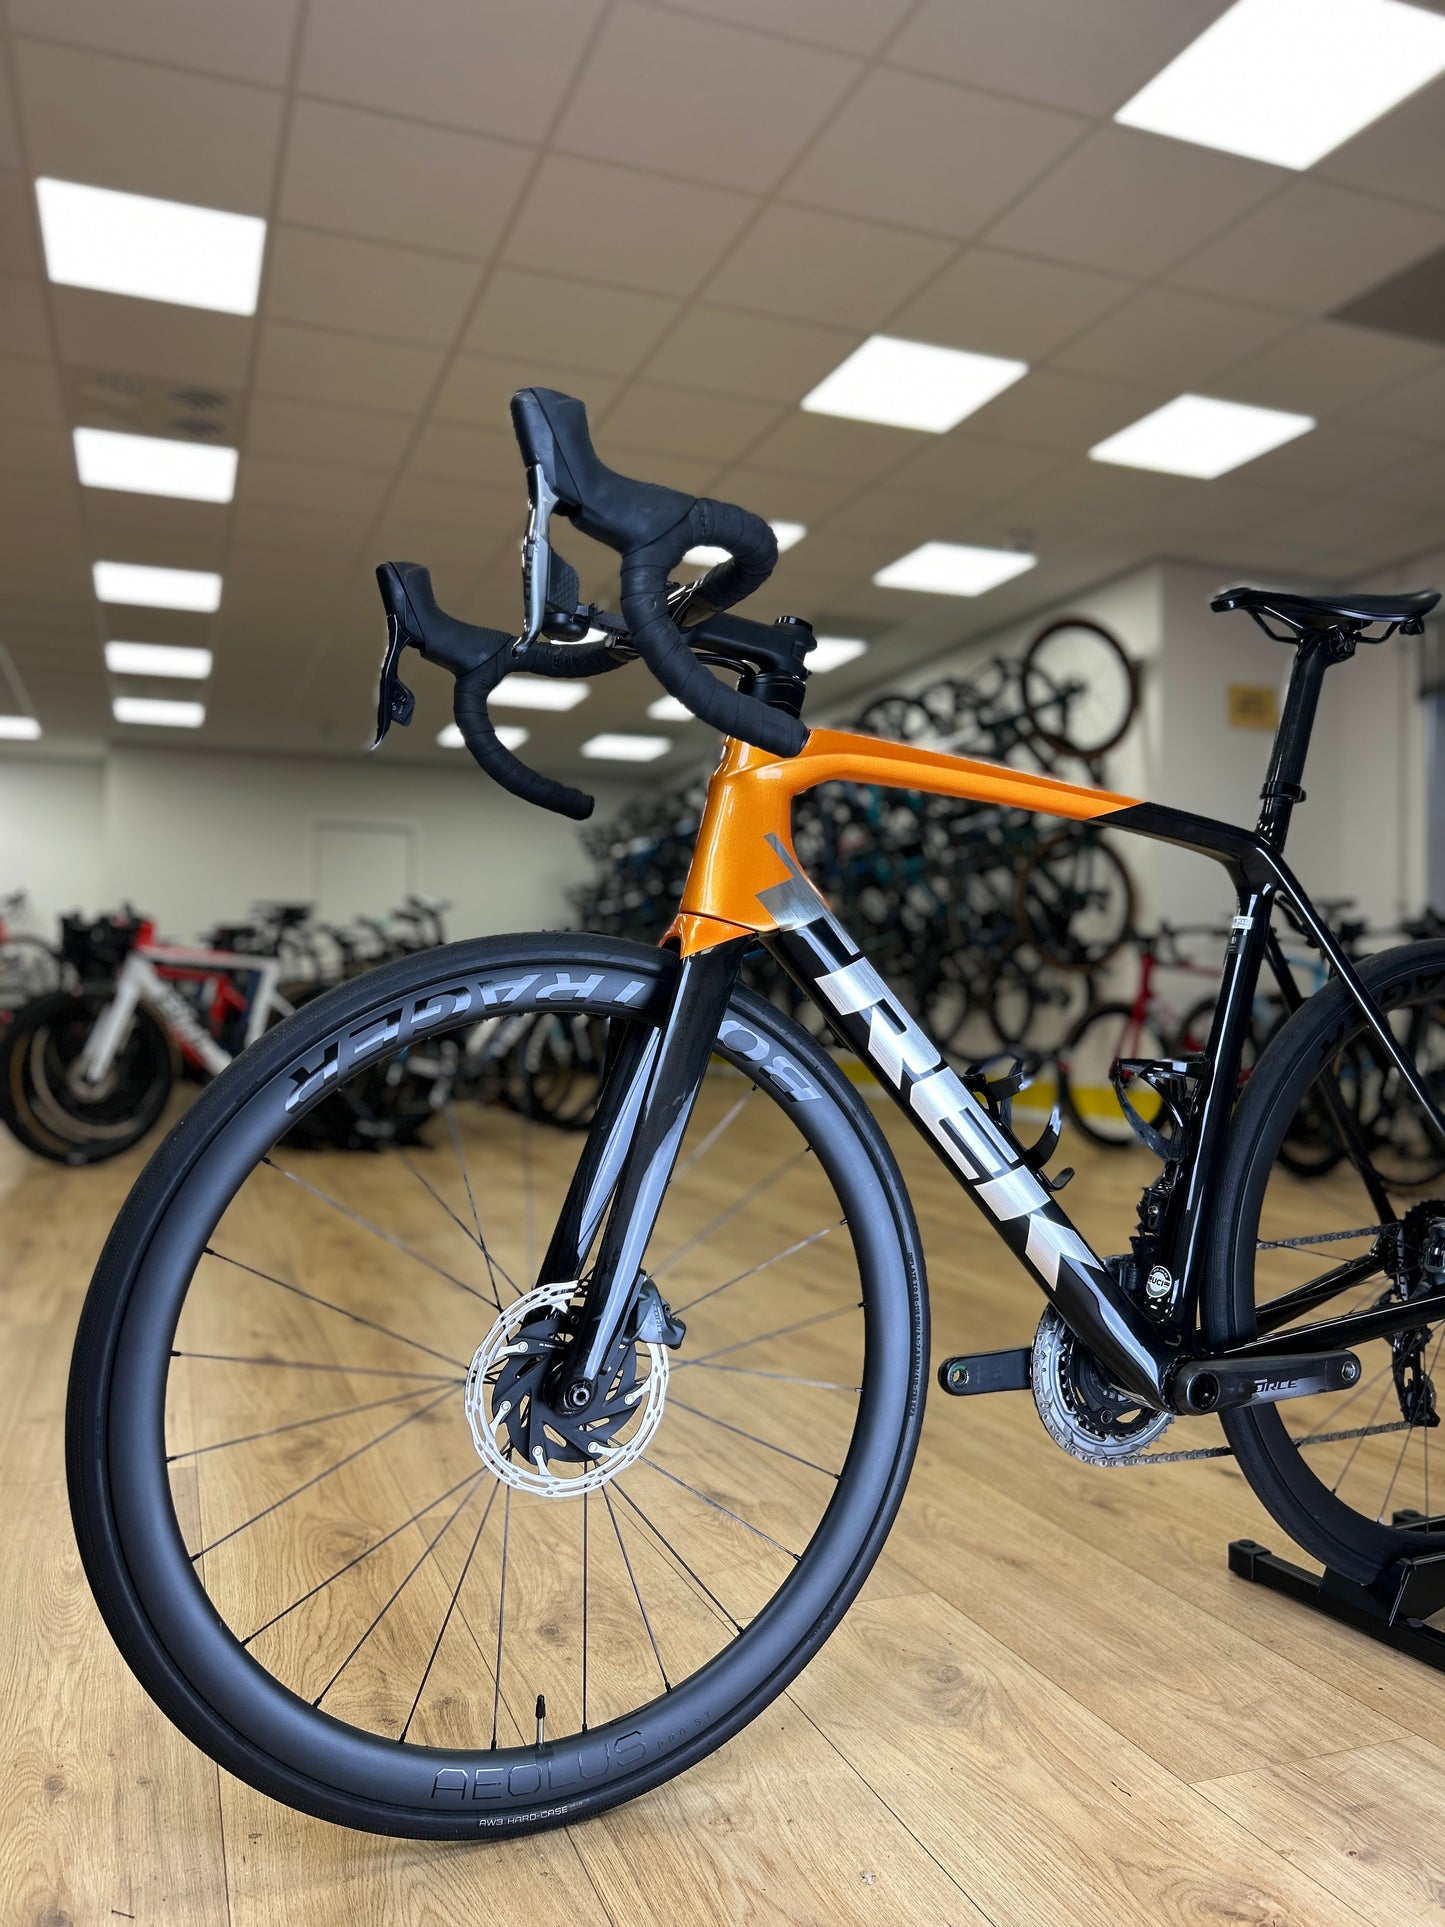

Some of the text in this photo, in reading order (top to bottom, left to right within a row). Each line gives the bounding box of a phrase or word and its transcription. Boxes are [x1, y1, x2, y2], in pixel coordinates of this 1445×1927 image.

[284, 971, 822, 1114] BOTRAGER
[755, 832, 1105, 1292] TREK
[1151, 1276, 1164, 1287] UCI
[430, 1730, 646, 1801] AEOLUS
[479, 1805, 568, 1828] AW3 HARD-CASE
